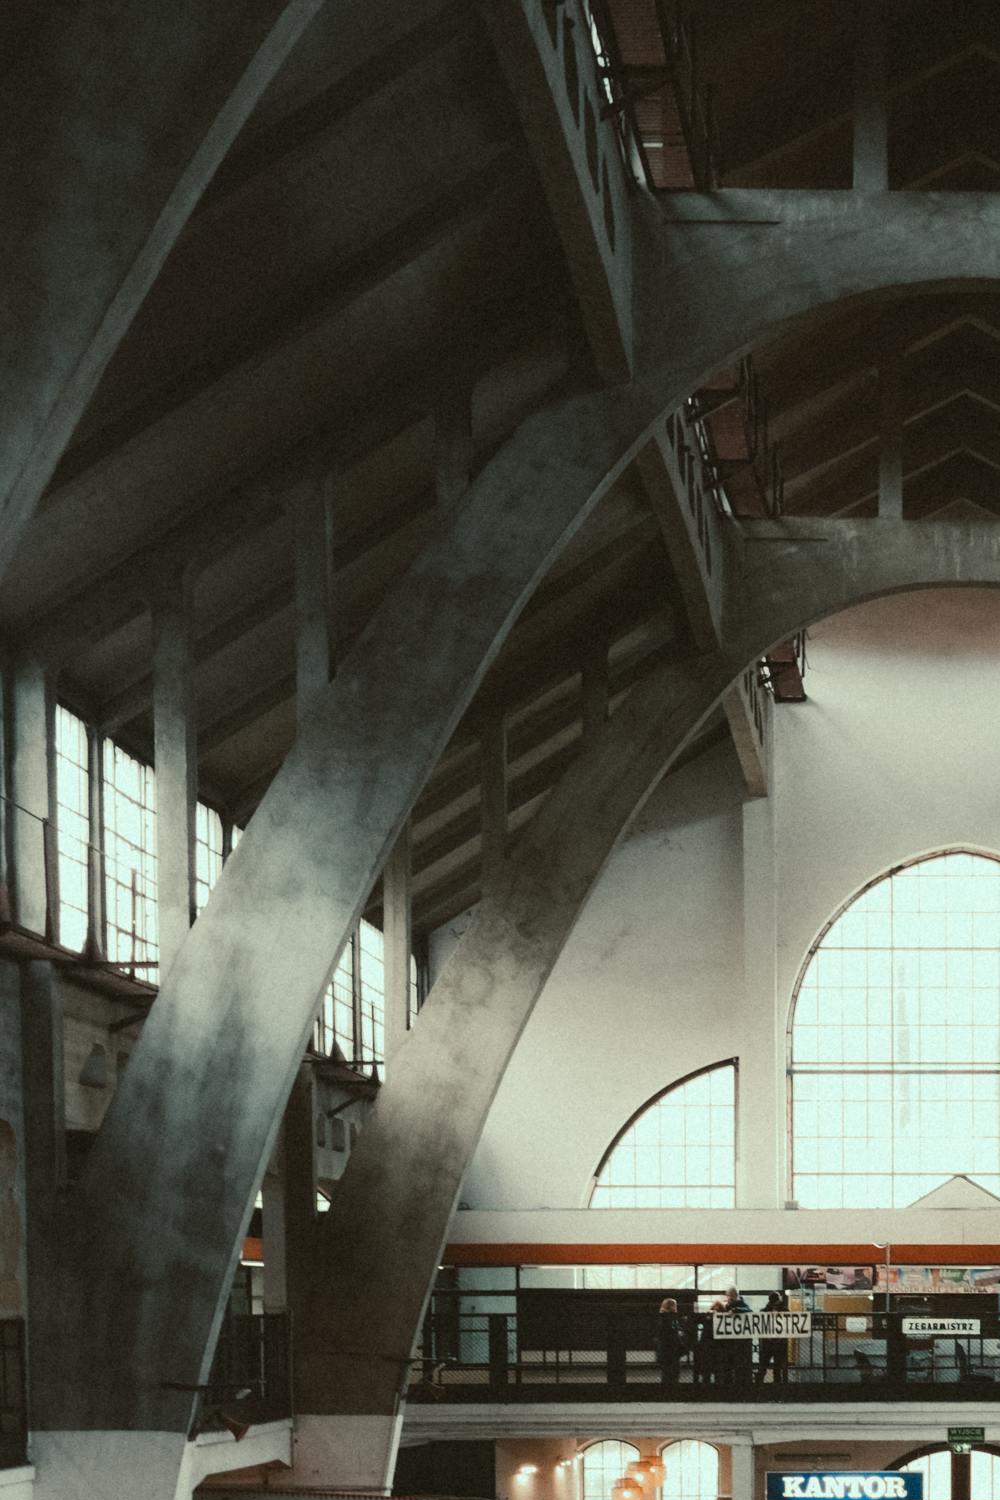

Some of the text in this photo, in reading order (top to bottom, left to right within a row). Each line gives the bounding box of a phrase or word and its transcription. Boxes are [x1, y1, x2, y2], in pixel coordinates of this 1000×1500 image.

[715, 1312, 809, 1336] ZEGARMISTRZ
[908, 1322, 974, 1331] ZEGARMISTRZ
[782, 1475, 908, 1500] KANTOR
